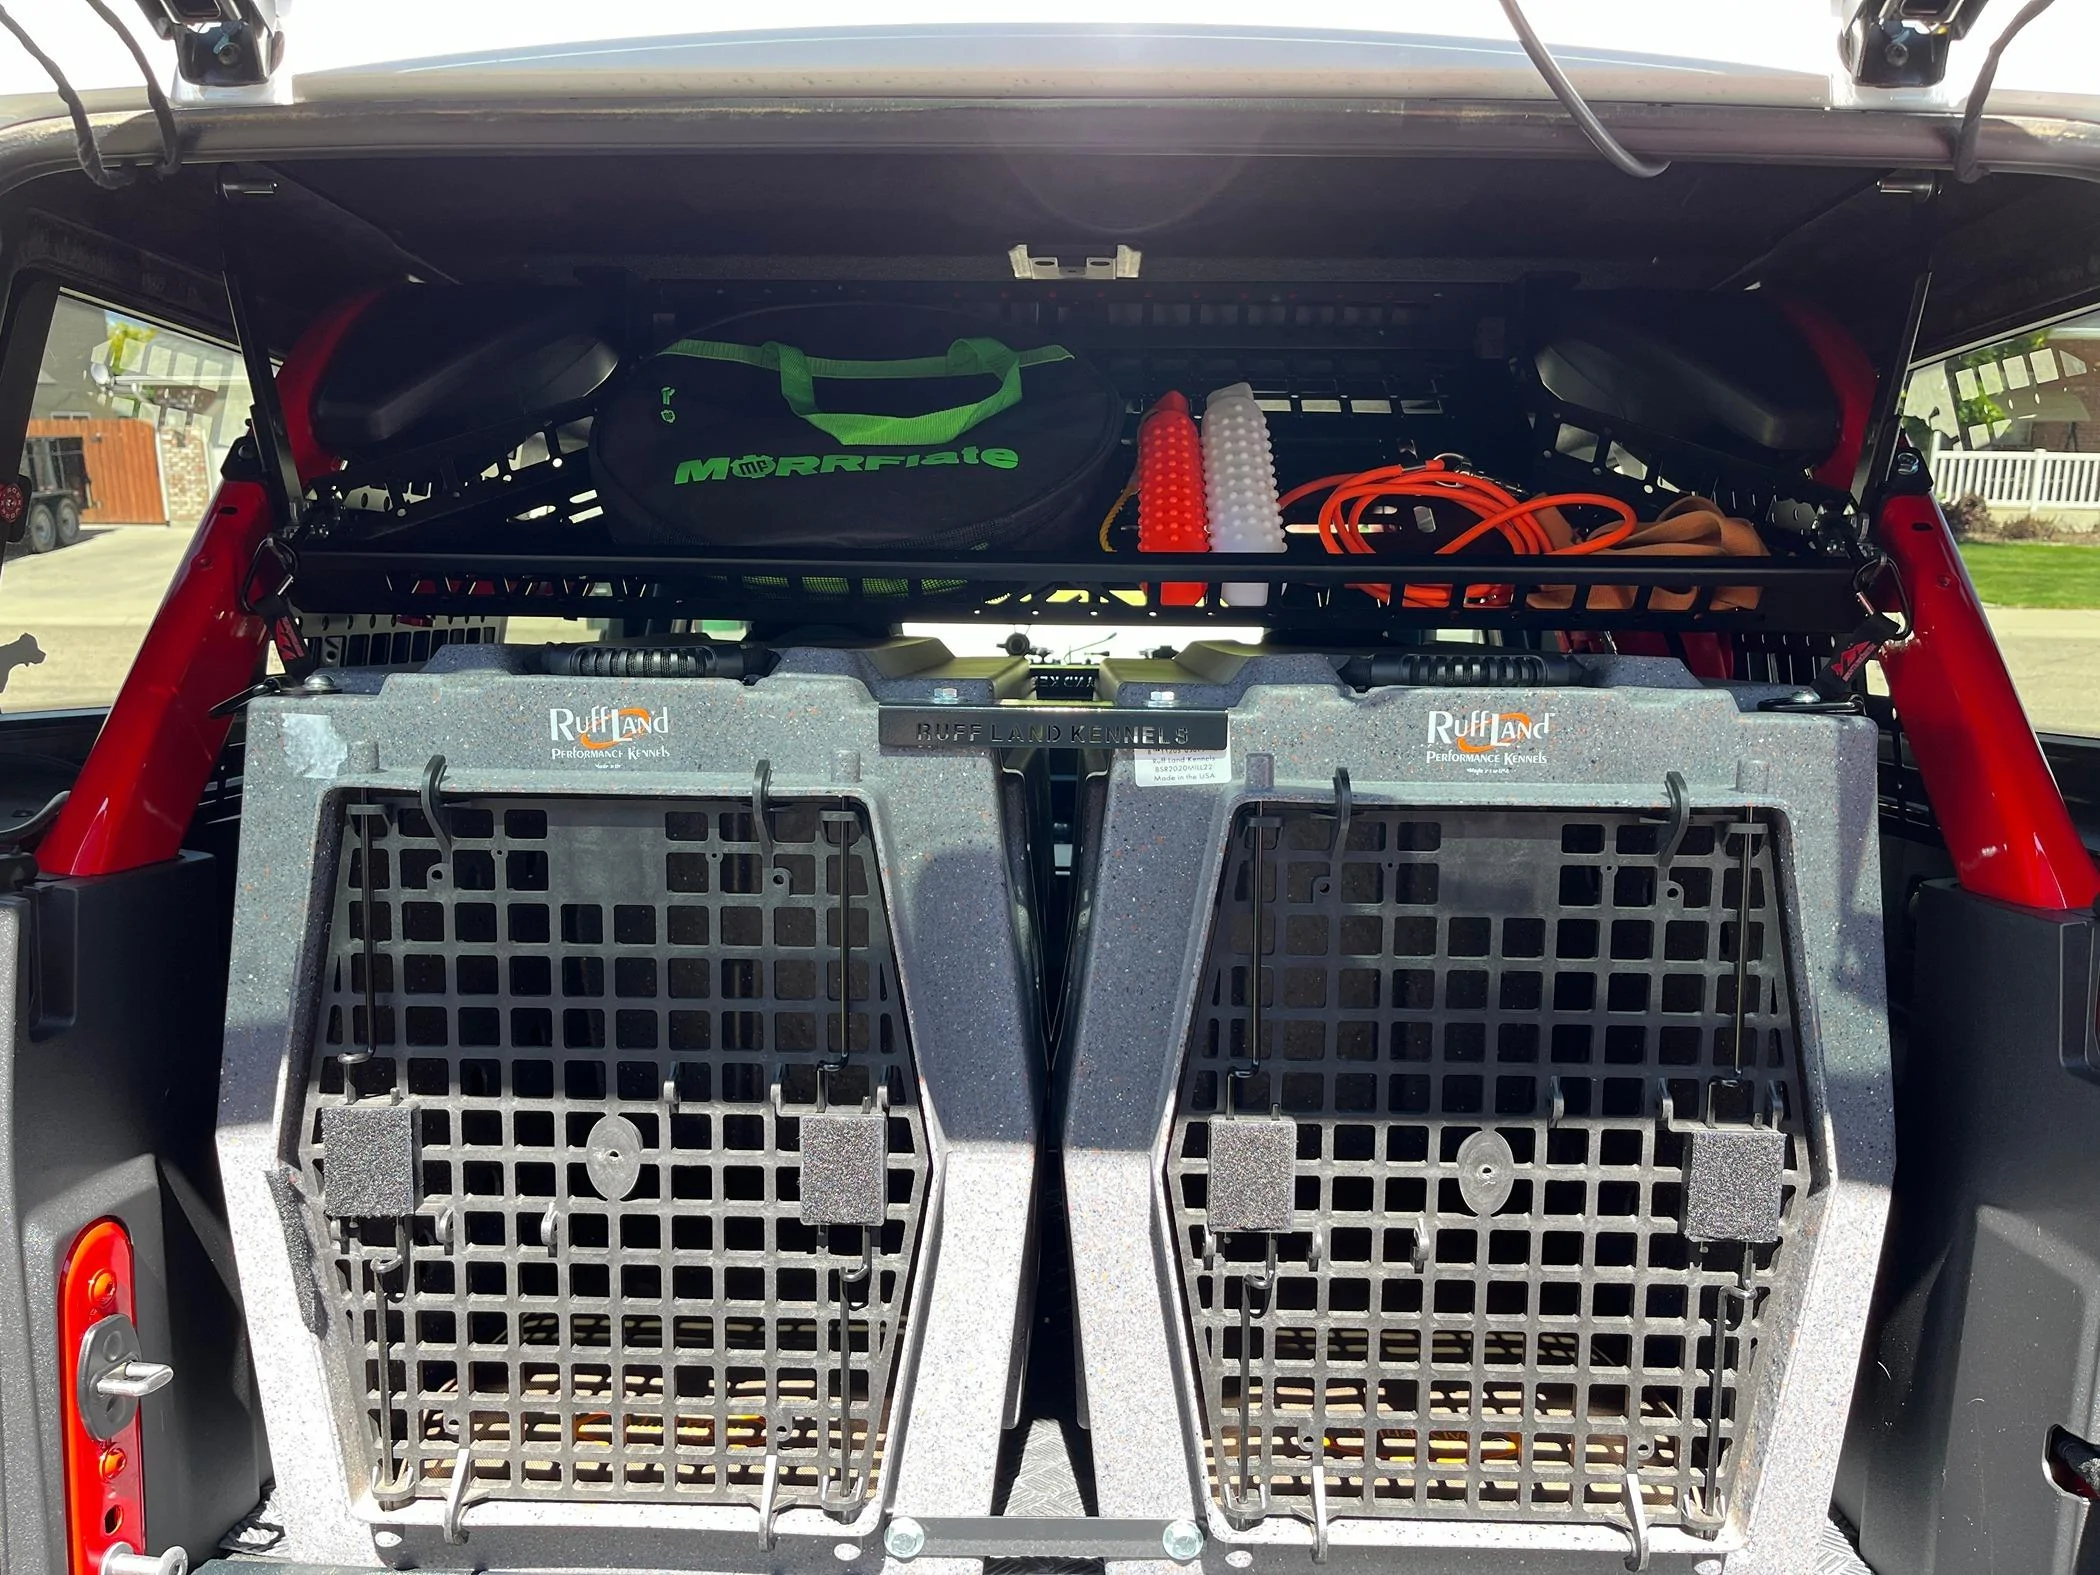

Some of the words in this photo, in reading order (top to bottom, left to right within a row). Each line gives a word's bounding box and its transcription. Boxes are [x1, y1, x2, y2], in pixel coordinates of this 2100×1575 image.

[917, 723, 982, 741] RUFF
[991, 724, 1062, 743] LAND
[1070, 725, 1190, 745] KENNELS
[1167, 756, 1186, 764] Land
[1153, 774, 1176, 782] Made
[1185, 772, 1198, 781] the
[1199, 772, 1216, 780] USA
